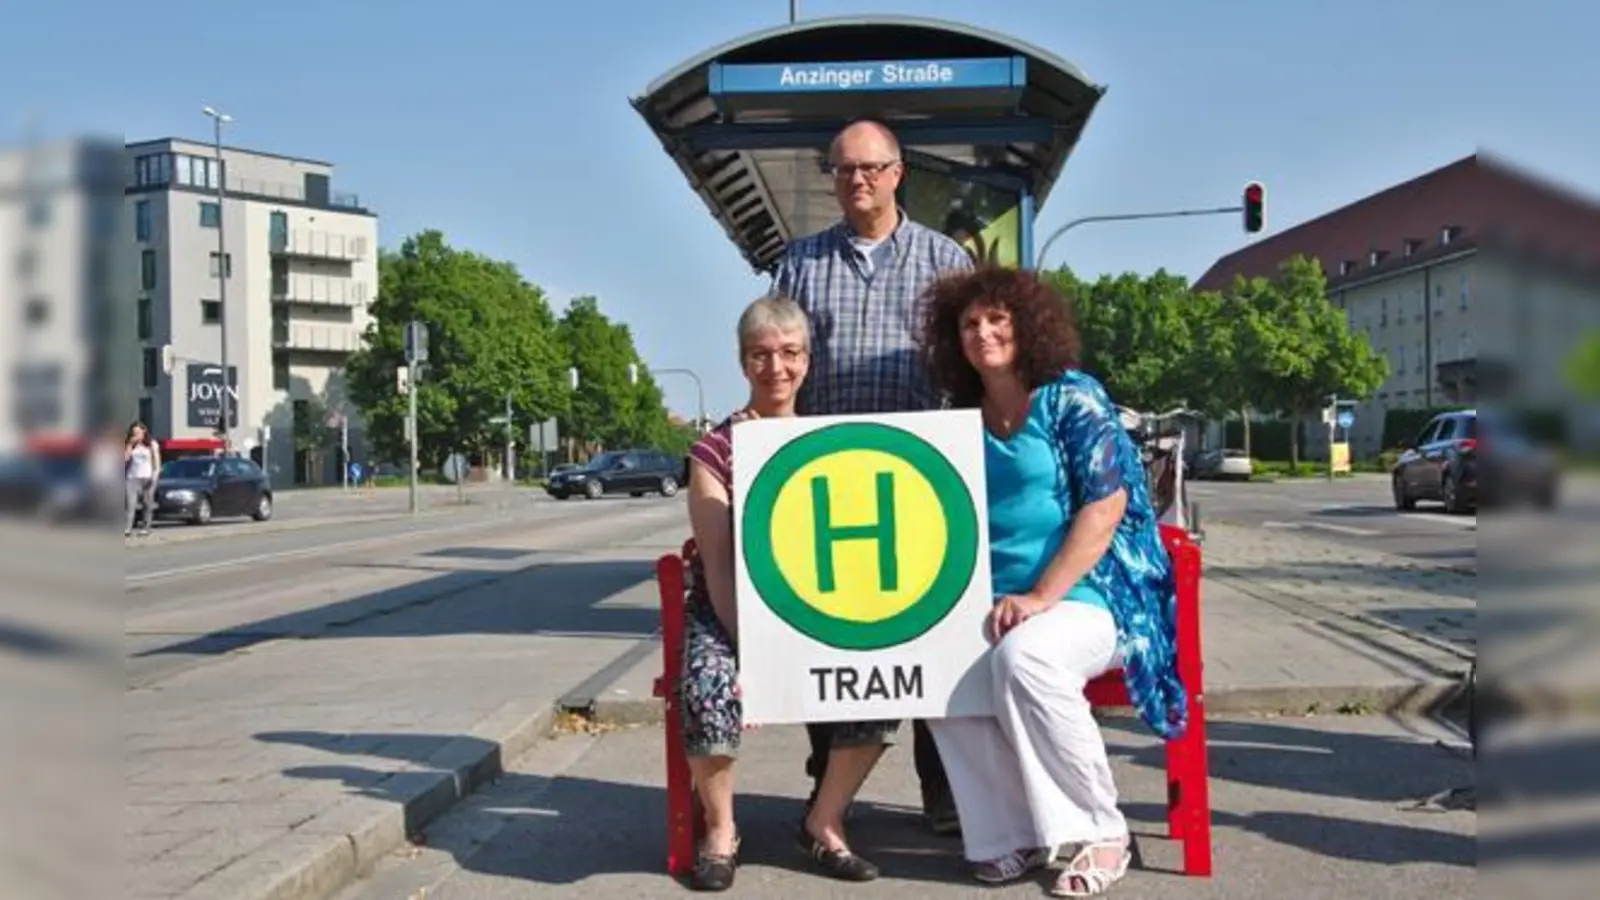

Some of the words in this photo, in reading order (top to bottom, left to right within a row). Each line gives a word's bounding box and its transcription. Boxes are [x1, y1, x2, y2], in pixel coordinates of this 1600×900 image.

[780, 65, 872, 88] Anzinger
[882, 63, 954, 83] Straße
[811, 470, 899, 593] H
[809, 665, 924, 701] TRAM
